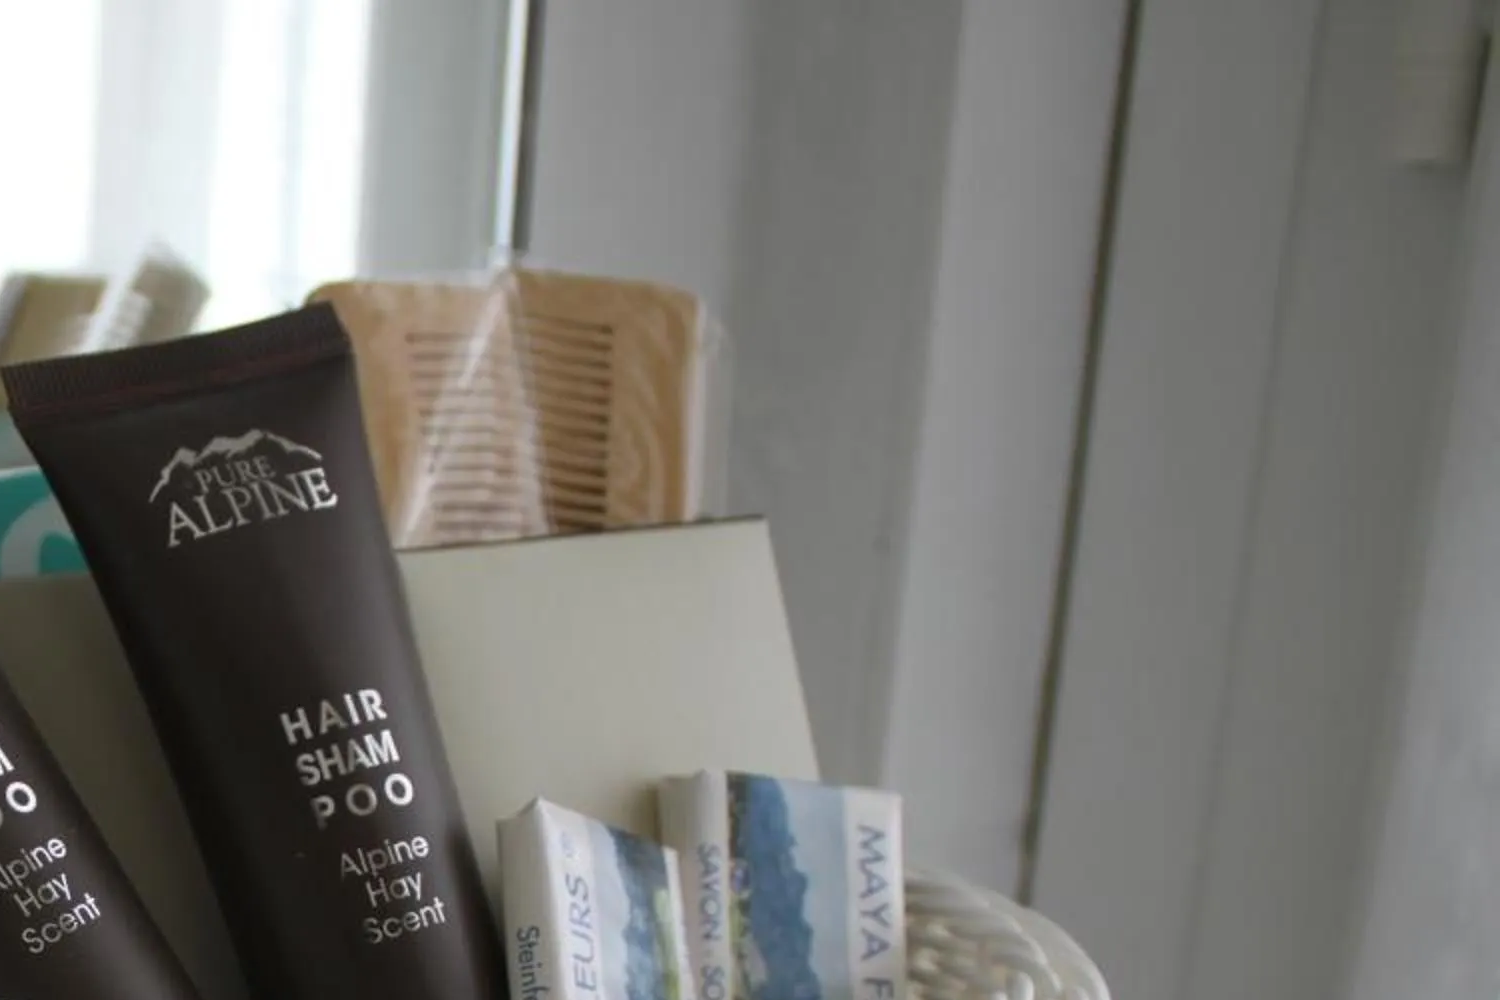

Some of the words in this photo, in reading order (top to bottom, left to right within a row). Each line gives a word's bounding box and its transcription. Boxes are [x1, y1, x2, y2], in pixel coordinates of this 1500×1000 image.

[194, 455, 276, 494] PURE
[168, 466, 338, 547] ALPINE
[280, 689, 388, 745] HAIR
[296, 729, 400, 786] SHAM
[310, 773, 414, 830] POO
[340, 836, 430, 878] Alpine
[13, 873, 72, 917] Hay
[366, 872, 422, 907] Hay
[699, 842, 723, 942] SAVON
[857, 824, 892, 962] MAYA
[22, 892, 100, 954] Scent
[363, 897, 446, 944] Scent
